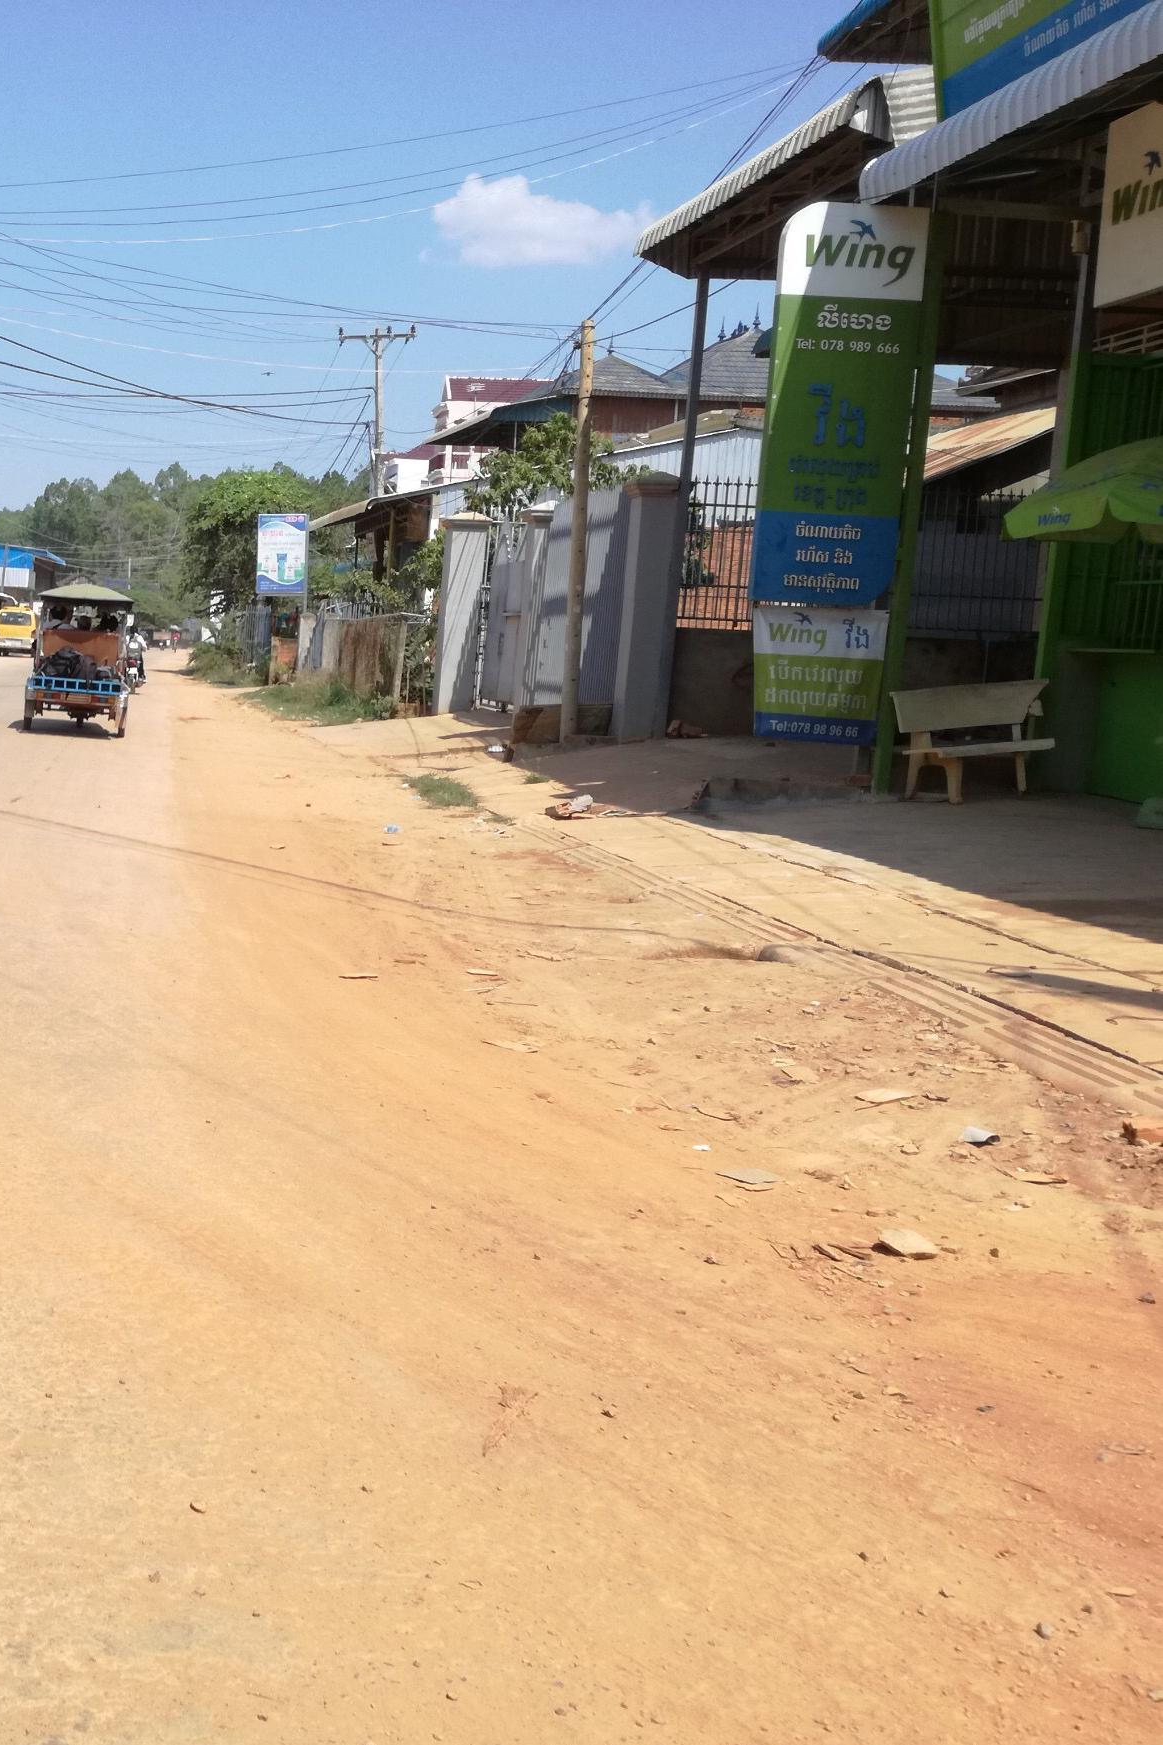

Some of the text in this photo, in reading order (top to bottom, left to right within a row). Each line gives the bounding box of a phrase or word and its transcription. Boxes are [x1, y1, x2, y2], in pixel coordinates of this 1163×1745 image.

[806, 234, 915, 287] Wing
[816, 304, 892, 331] លីហេង
[796, 338, 900, 355] Tel: 078 989 666
[795, 520, 862, 541] ចំណាយតិច
[1038, 513, 1071, 526] Wing
[795, 545, 853, 565] រហ័ស និង
[768, 622, 828, 655] Wing
[842, 617, 870, 649] វីង
